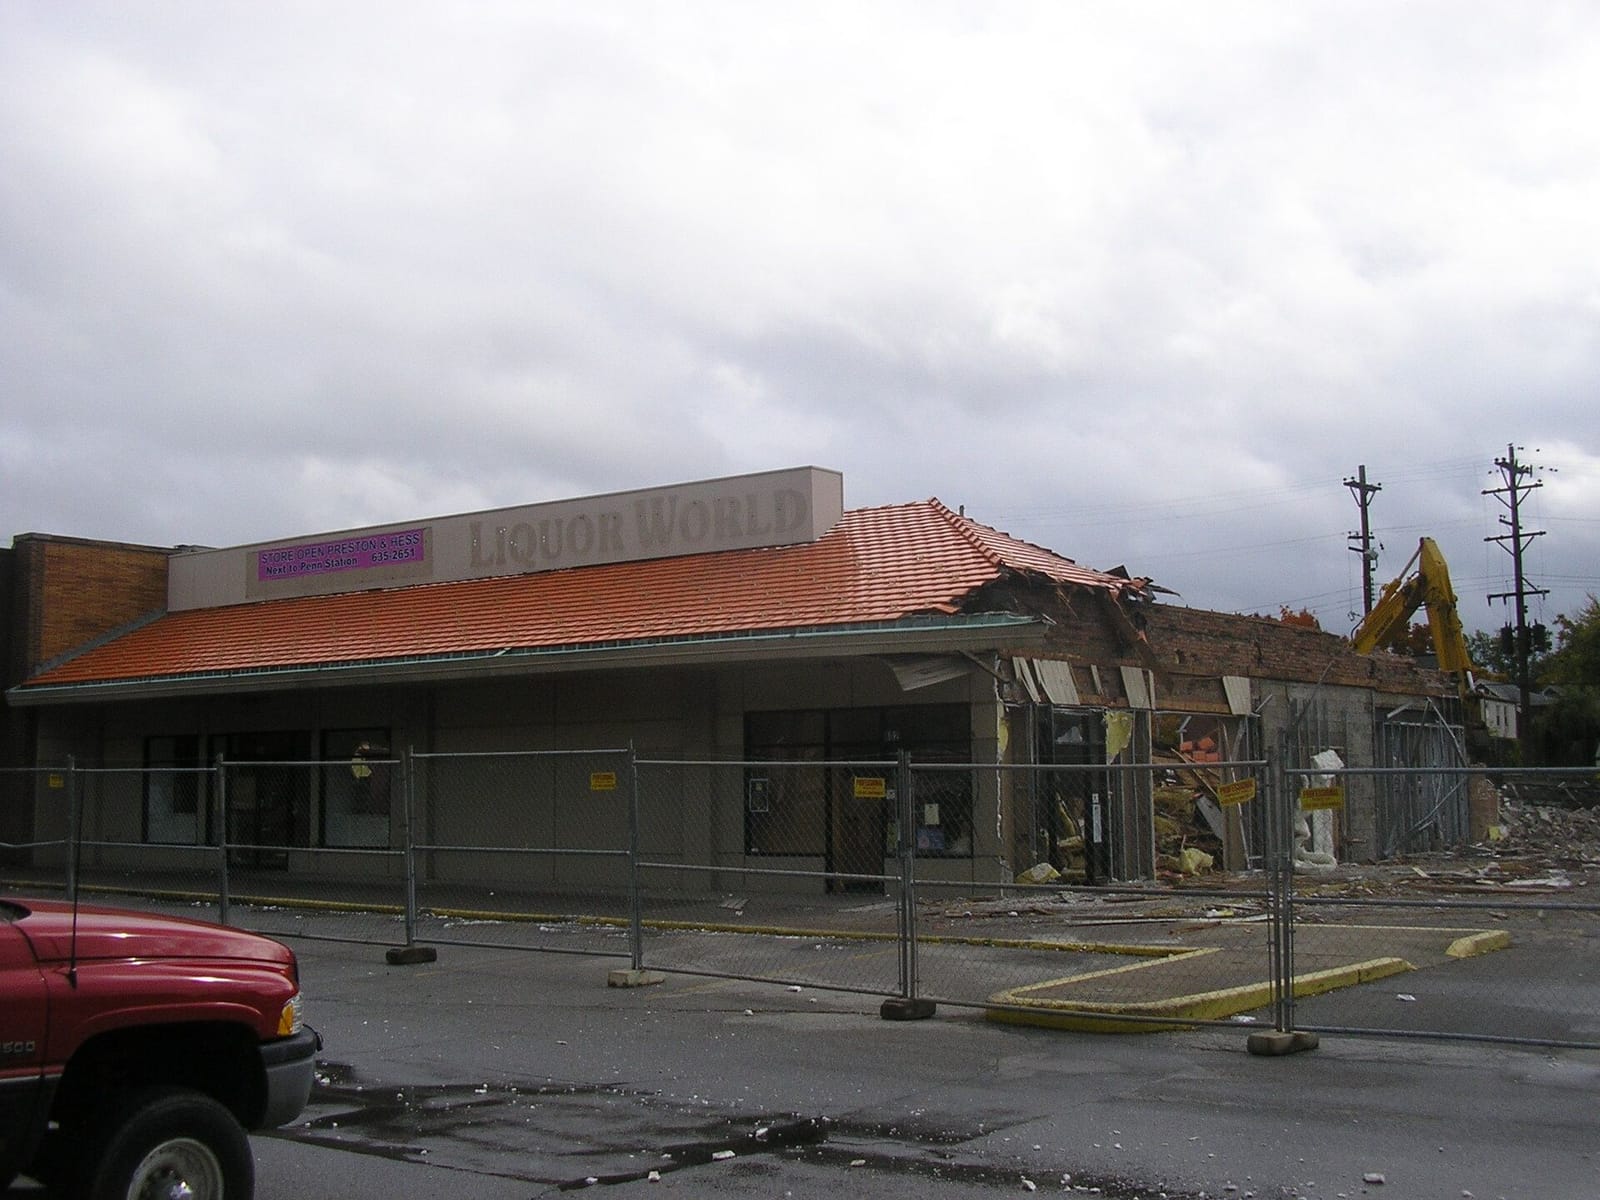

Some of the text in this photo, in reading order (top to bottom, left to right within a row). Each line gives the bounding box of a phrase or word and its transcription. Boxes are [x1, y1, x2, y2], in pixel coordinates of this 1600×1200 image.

[469, 488, 807, 569] LIQUOR WORLD
[261, 533, 420, 564] STORE OPEN PRESTON & HESS
[371, 548, 415, 562] 635-2651
[266, 556, 358, 575] Next to Penn Station
